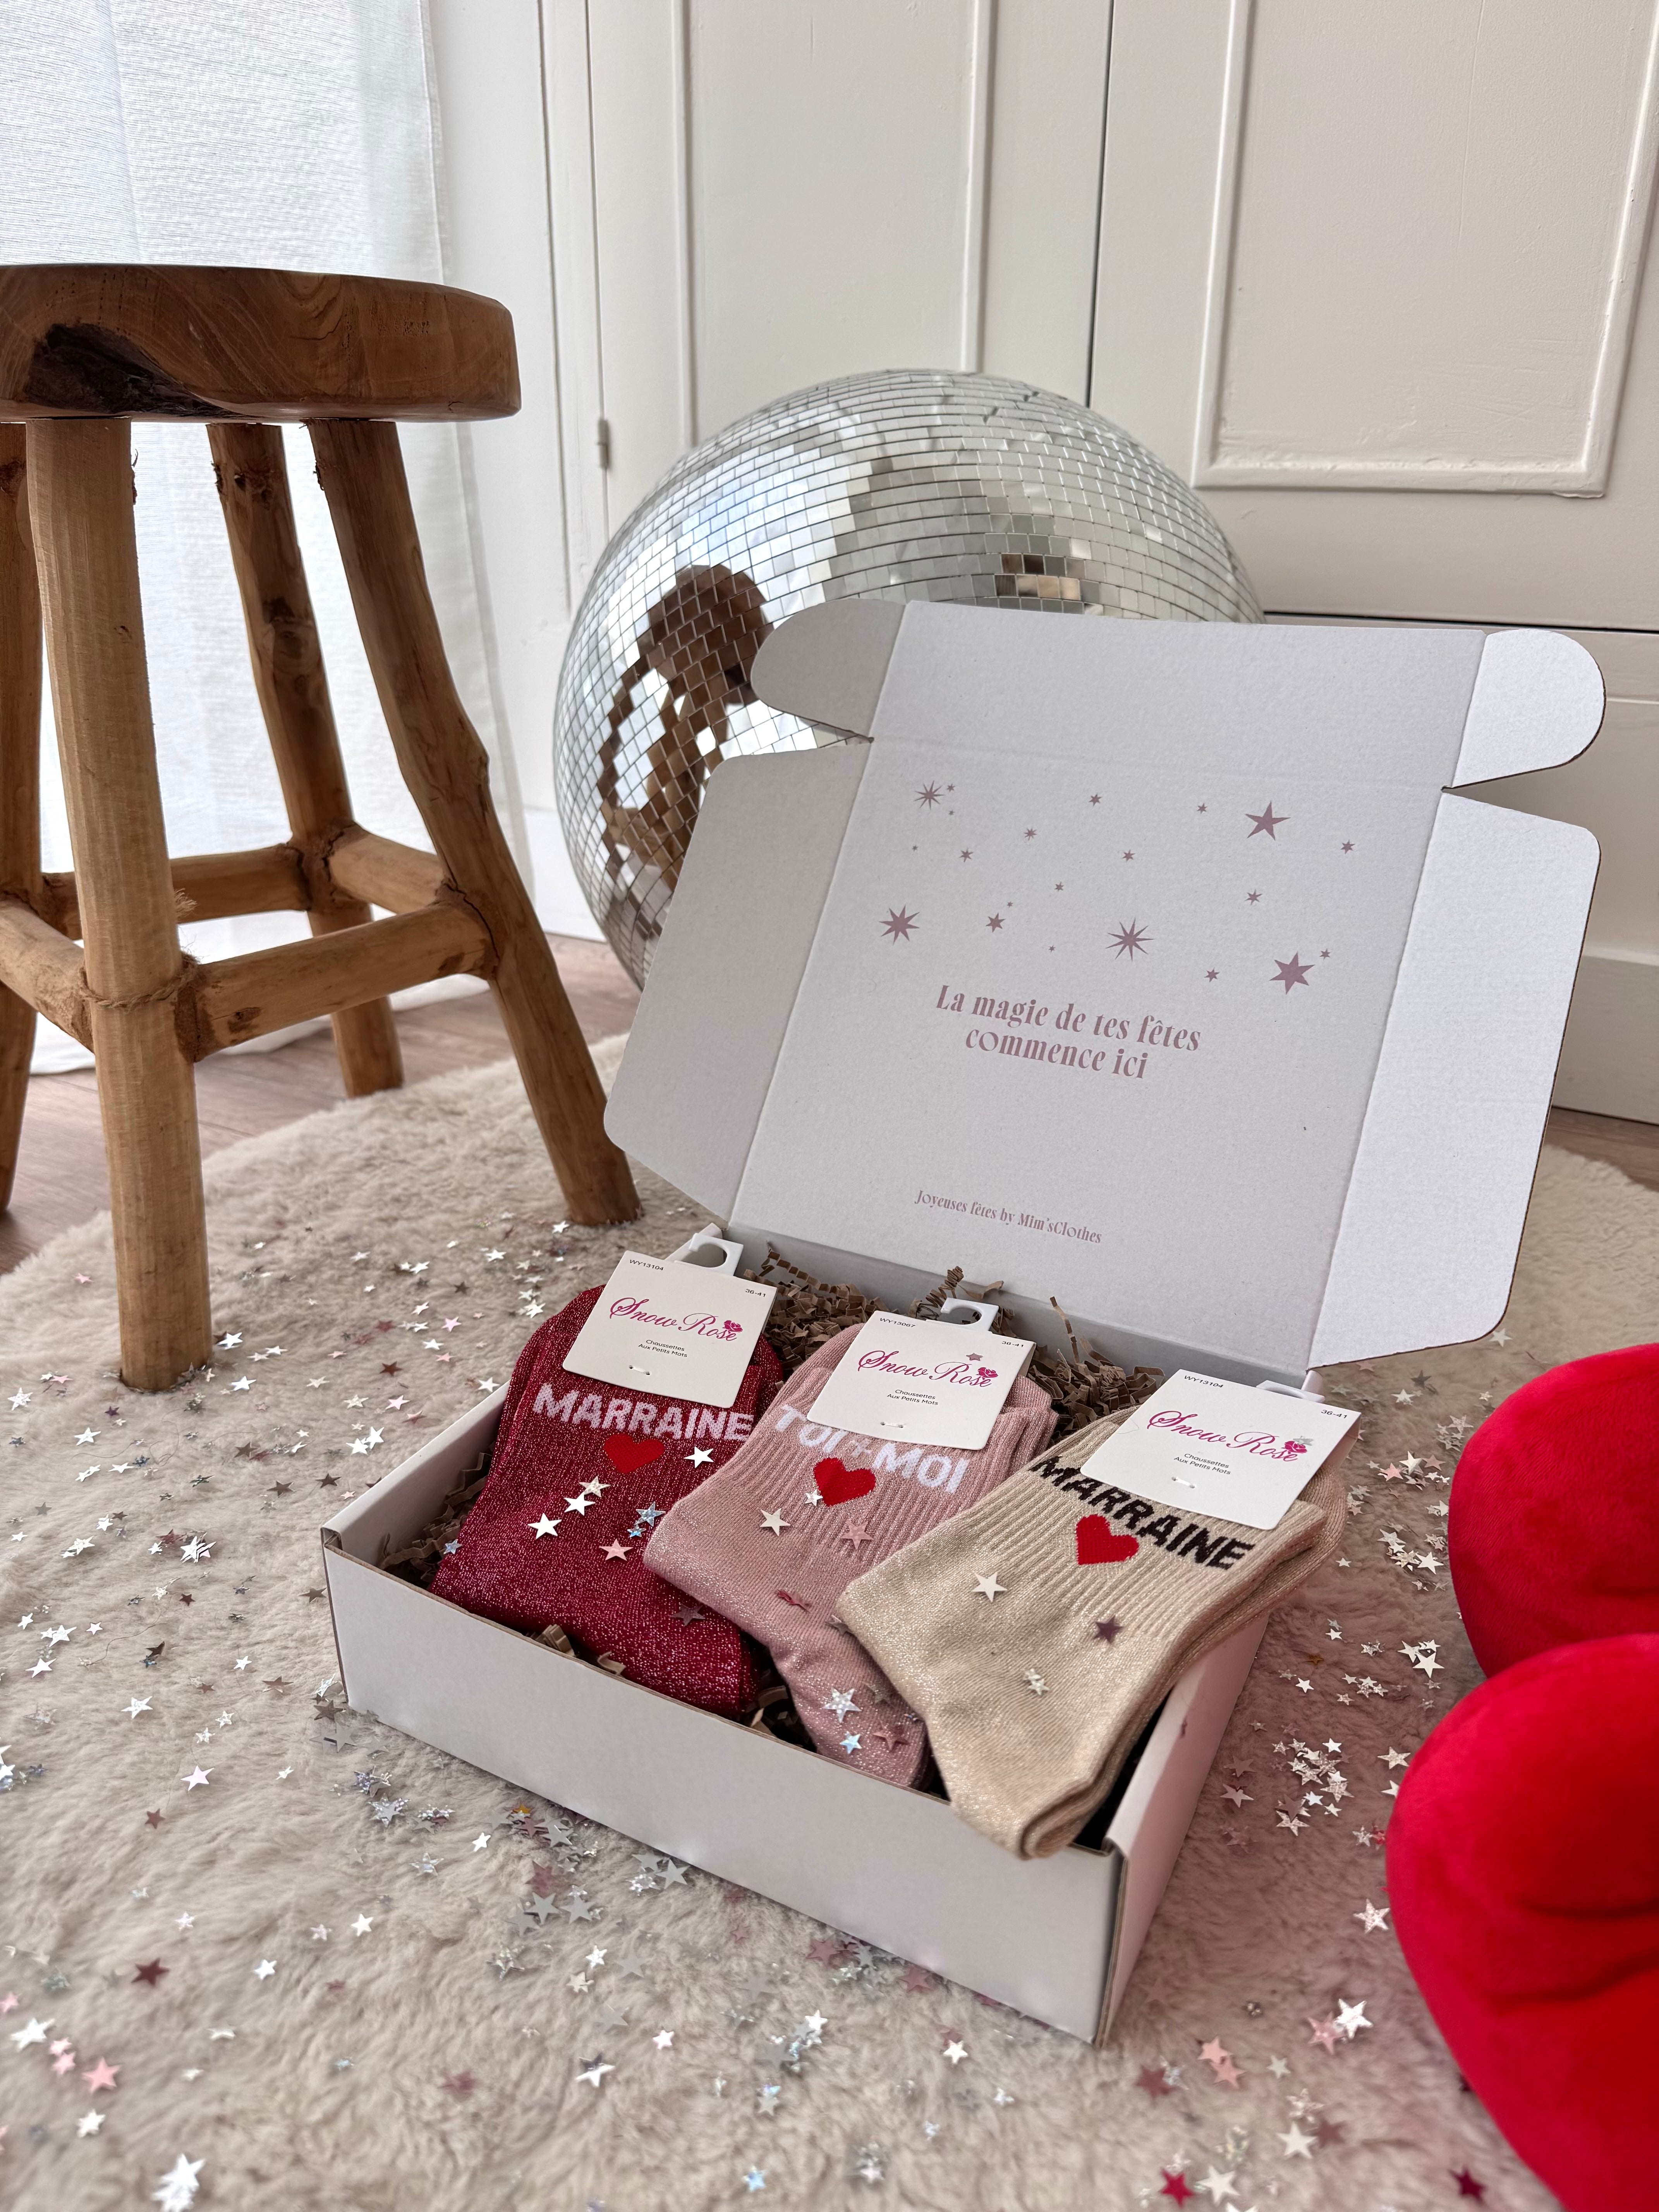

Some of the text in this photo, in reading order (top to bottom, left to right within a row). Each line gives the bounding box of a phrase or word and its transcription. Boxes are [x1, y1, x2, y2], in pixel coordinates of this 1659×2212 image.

[936, 985, 1200, 1051] La magie de tes fêtes
[966, 1029, 1149, 1078] commence ici
[915, 1190, 967, 1212] Joyeuses
[970, 1201, 997, 1219] fêtes
[1000, 1208, 1015, 1225] by
[630, 1259, 664, 1271] WY13104
[745, 1288, 766, 1297] 36-41
[610, 1297, 737, 1341] Snow Rose
[880, 1317, 915, 1327] WY13067
[646, 1340, 685, 1351] Chaussettes
[858, 1350, 992, 1388] Snow Rose
[1184, 1375, 1223, 1388] WY13104
[895, 1389, 936, 1399] Chaussettes
[533, 1382, 754, 1441] MARRAINE
[1321, 1409, 1347, 1419] 36-41
[1147, 1410, 1298, 1462] Snow Rose
[1184, 1453, 1229, 1468] Chaussettes
[1190, 1460, 1211, 1470] Petits
[1212, 1467, 1231, 1475] Mots
[1029, 1456, 1255, 1570] MARRAINE
